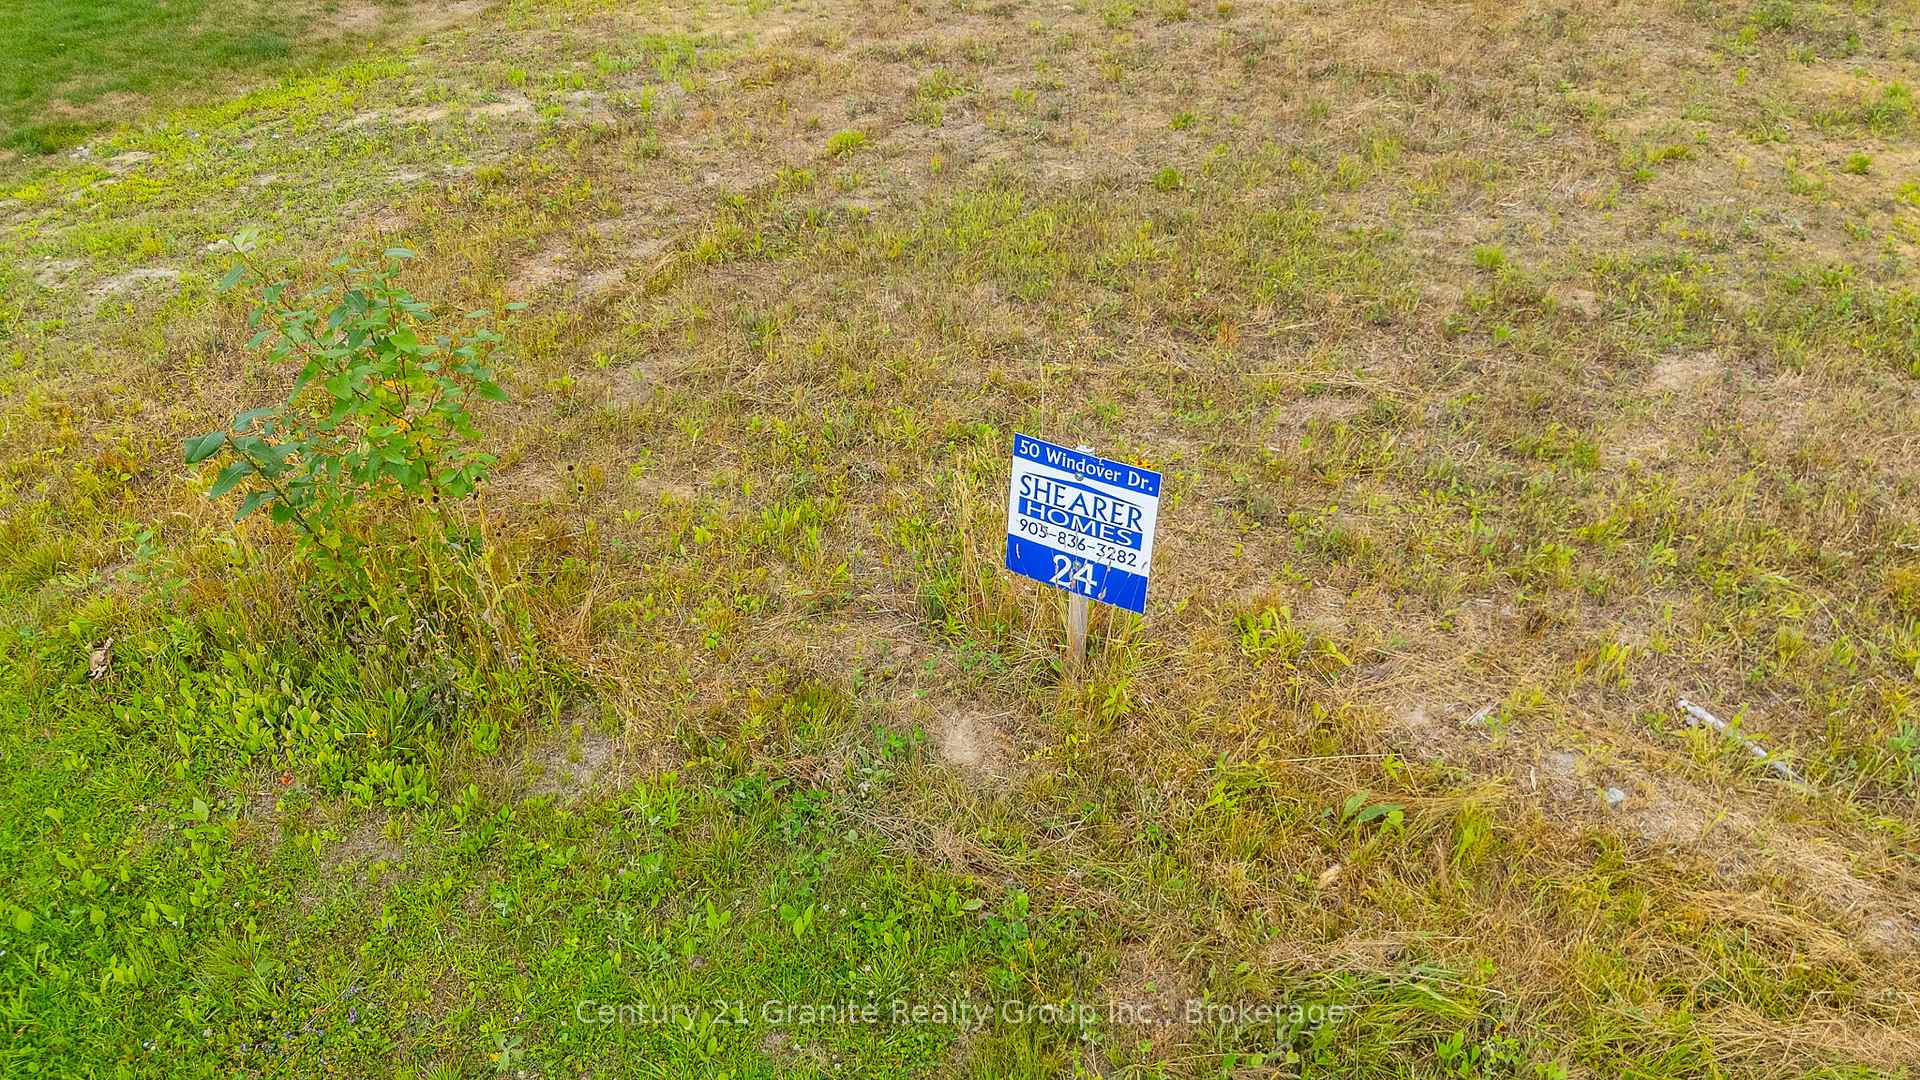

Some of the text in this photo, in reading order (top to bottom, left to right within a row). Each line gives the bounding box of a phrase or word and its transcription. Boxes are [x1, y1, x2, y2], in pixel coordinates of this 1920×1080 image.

[1019, 439, 1153, 492] 50 Windover Dr.
[1020, 474, 1143, 532] SHEARER
[1026, 500, 1133, 546] HOMES
[1019, 518, 1137, 568] 905-836-3282
[1050, 554, 1098, 595] 24
